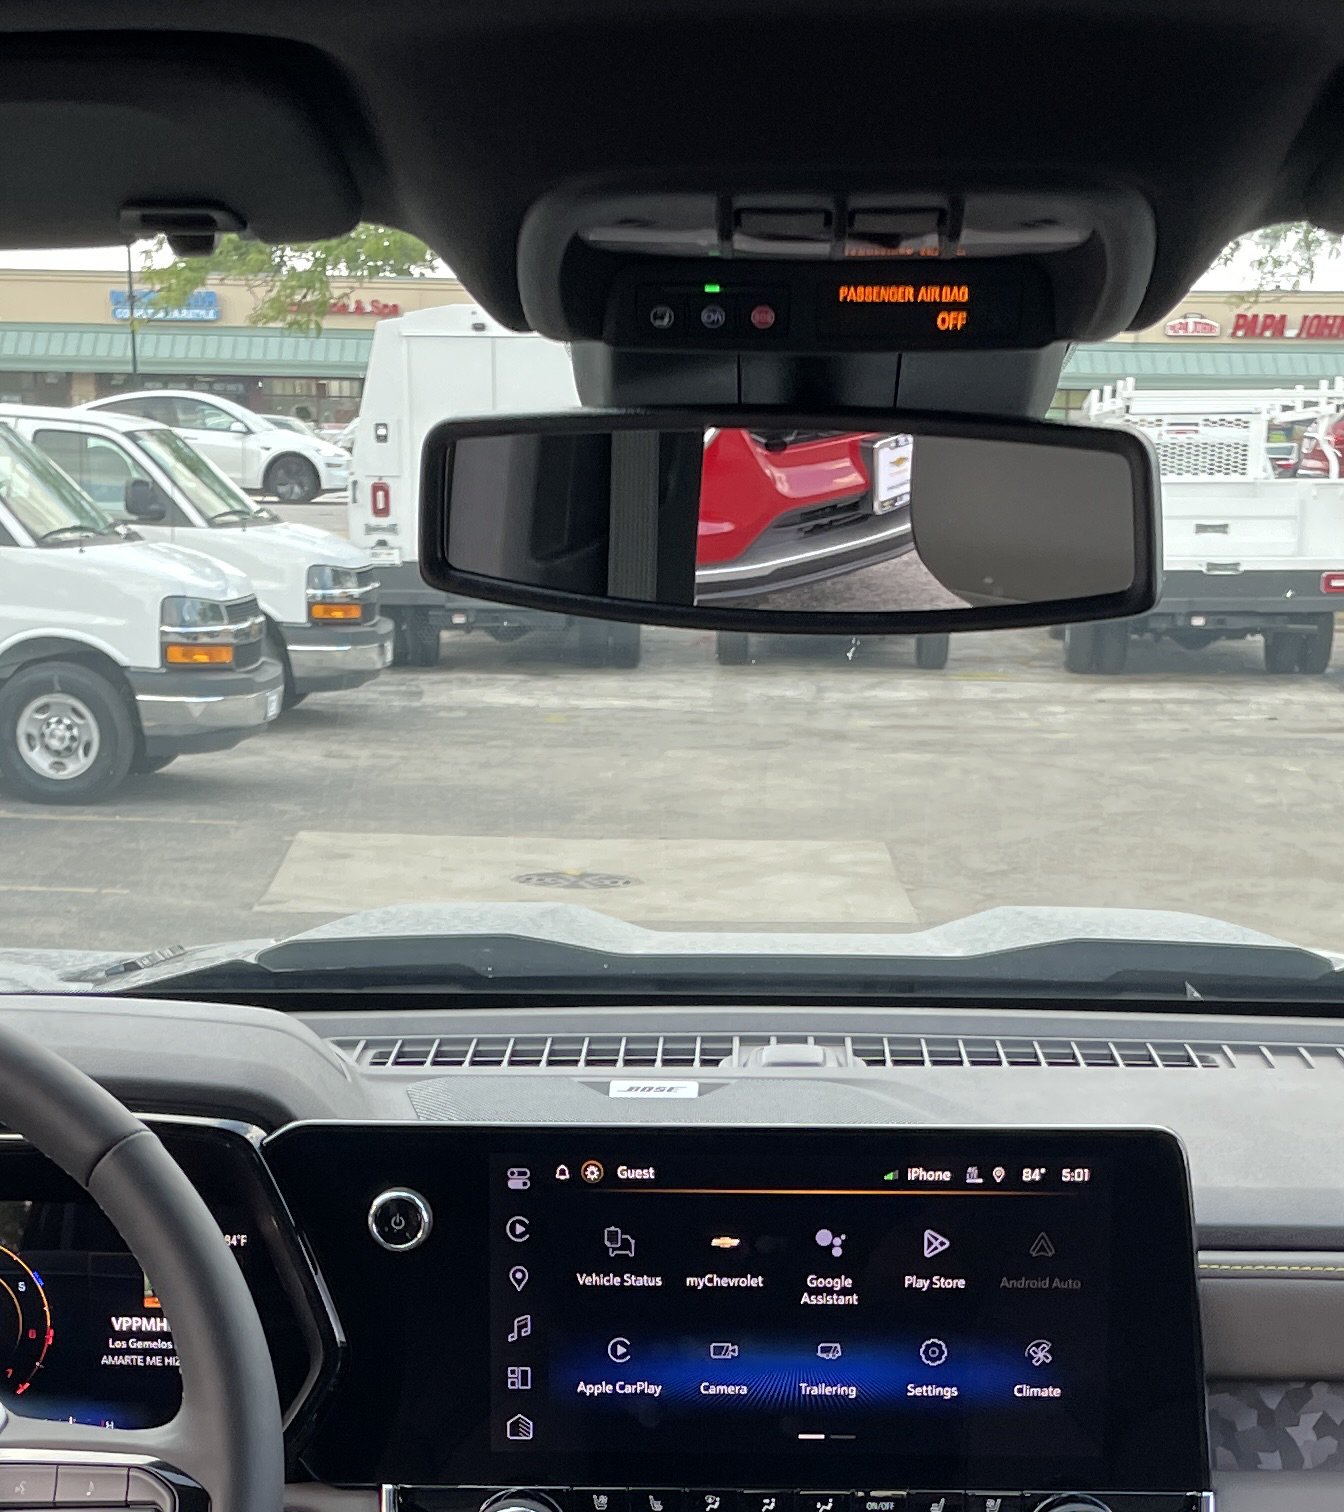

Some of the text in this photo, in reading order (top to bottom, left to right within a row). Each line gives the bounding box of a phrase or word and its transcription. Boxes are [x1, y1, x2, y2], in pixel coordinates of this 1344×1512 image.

[839, 285, 914, 303] PASSENGER
[936, 311, 967, 331] OFF
[1231, 313, 1287, 338] PAPA
[617, 1165, 655, 1180] Guest
[907, 1167, 952, 1181] iPhone
[1061, 1168, 1090, 1182] 5:01
[17, 1281, 26, 1292] 5
[576, 1272, 663, 1287] Vehicle Status
[686, 1273, 764, 1289] myChevrolet
[806, 1274, 853, 1291] Google
[904, 1275, 966, 1291] Play Store
[1000, 1276, 1082, 1290] Android Auto
[800, 1292, 859, 1305] Assistant
[109, 1338, 173, 1349] Los Gemelos
[101, 1356, 144, 1367] AMARTE
[146, 1356, 163, 1367] ME
[577, 1381, 662, 1397] Apple CarPlay
[700, 1382, 748, 1395] Camera
[799, 1383, 856, 1398] Trailering
[906, 1383, 958, 1399] Settings
[1014, 1384, 1061, 1398] Climate
[866, 1501, 895, 1511] ON/OFF
